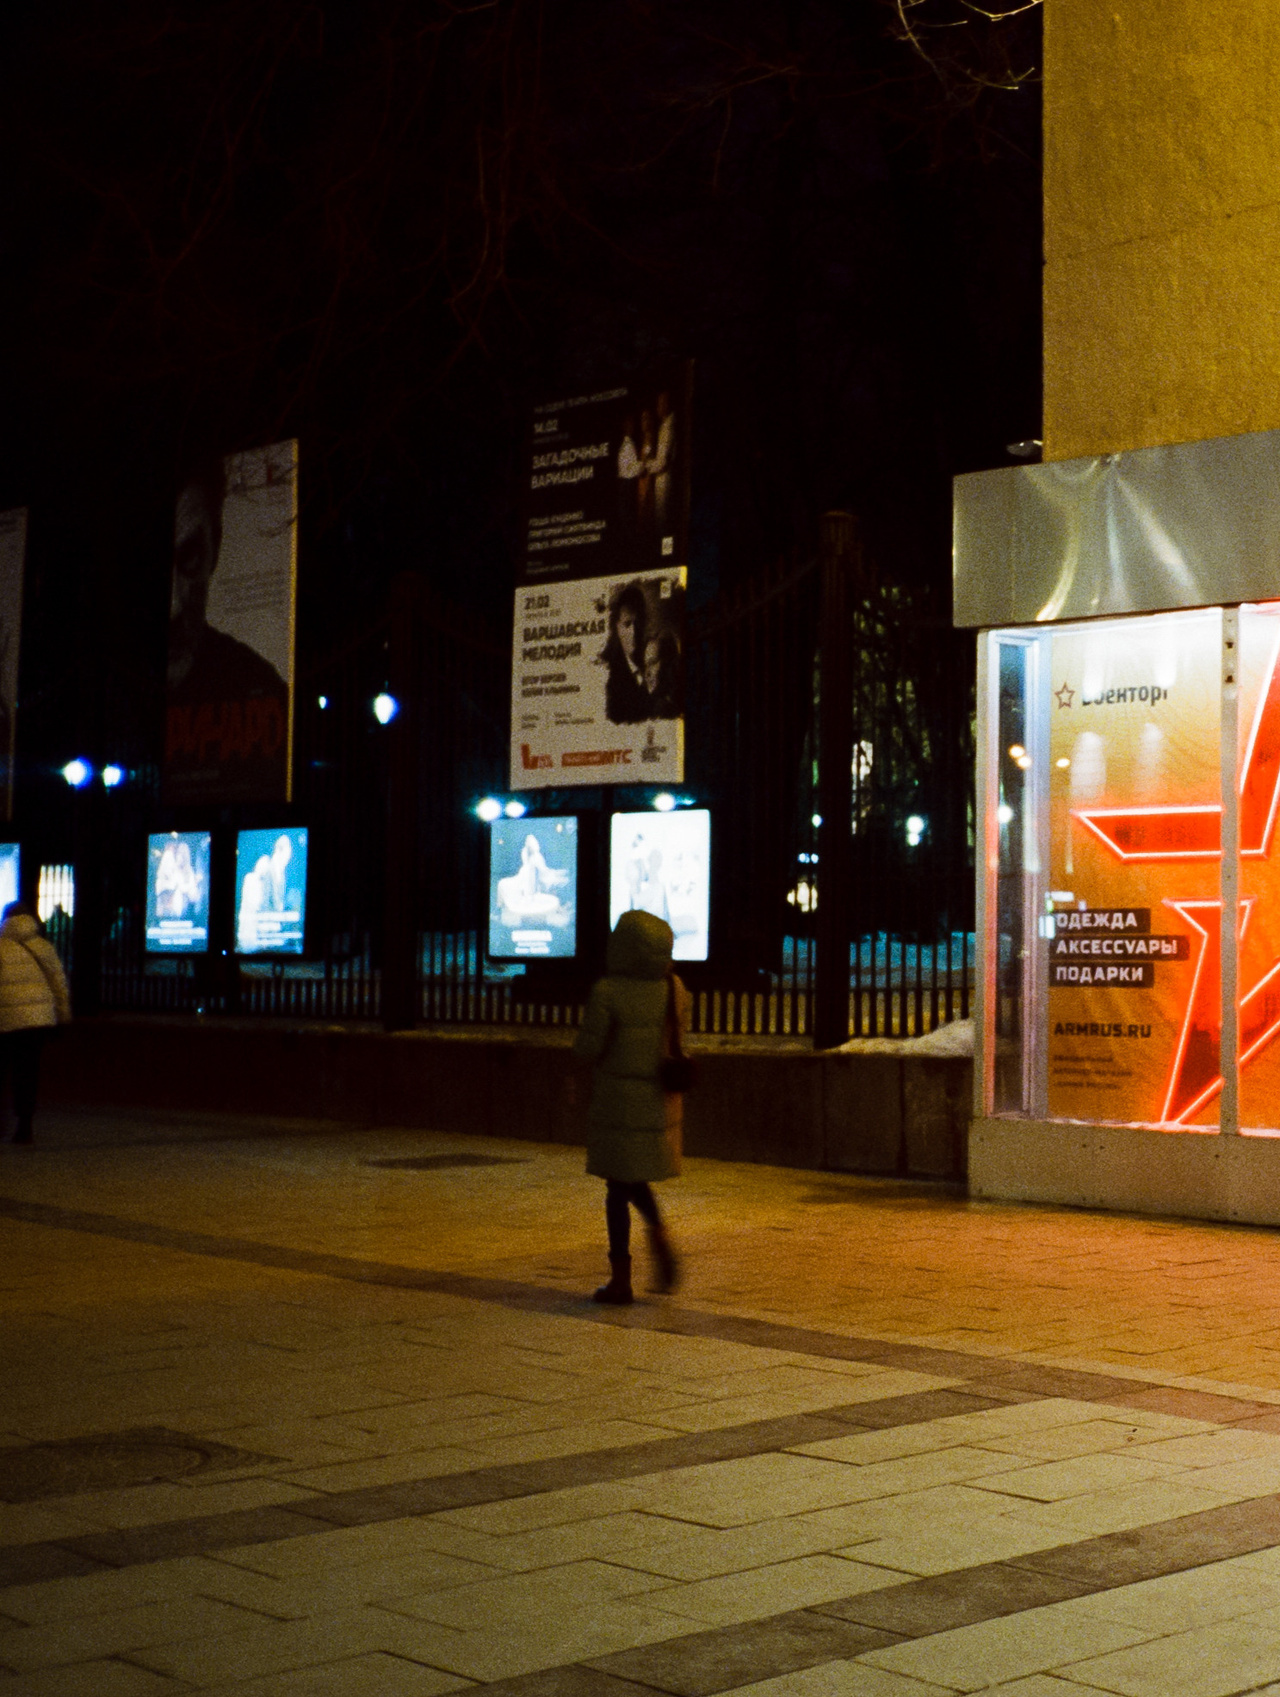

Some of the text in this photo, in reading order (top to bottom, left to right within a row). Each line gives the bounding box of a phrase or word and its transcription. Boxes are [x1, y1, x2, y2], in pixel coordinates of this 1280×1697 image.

[530, 465, 595, 489] ВАРИАЦИИ
[523, 618, 606, 642] ВАРШАВСКАЯ
[522, 642, 582, 661] МЕЛОДИЯ
[1056, 912, 1138, 930] ОДЕЖДА
[1055, 939, 1178, 955] АКСЕССУАРЫ
[1056, 966, 1144, 983] ПОДАРКИ
[1054, 1022, 1152, 1039] ARMRUS.RU
